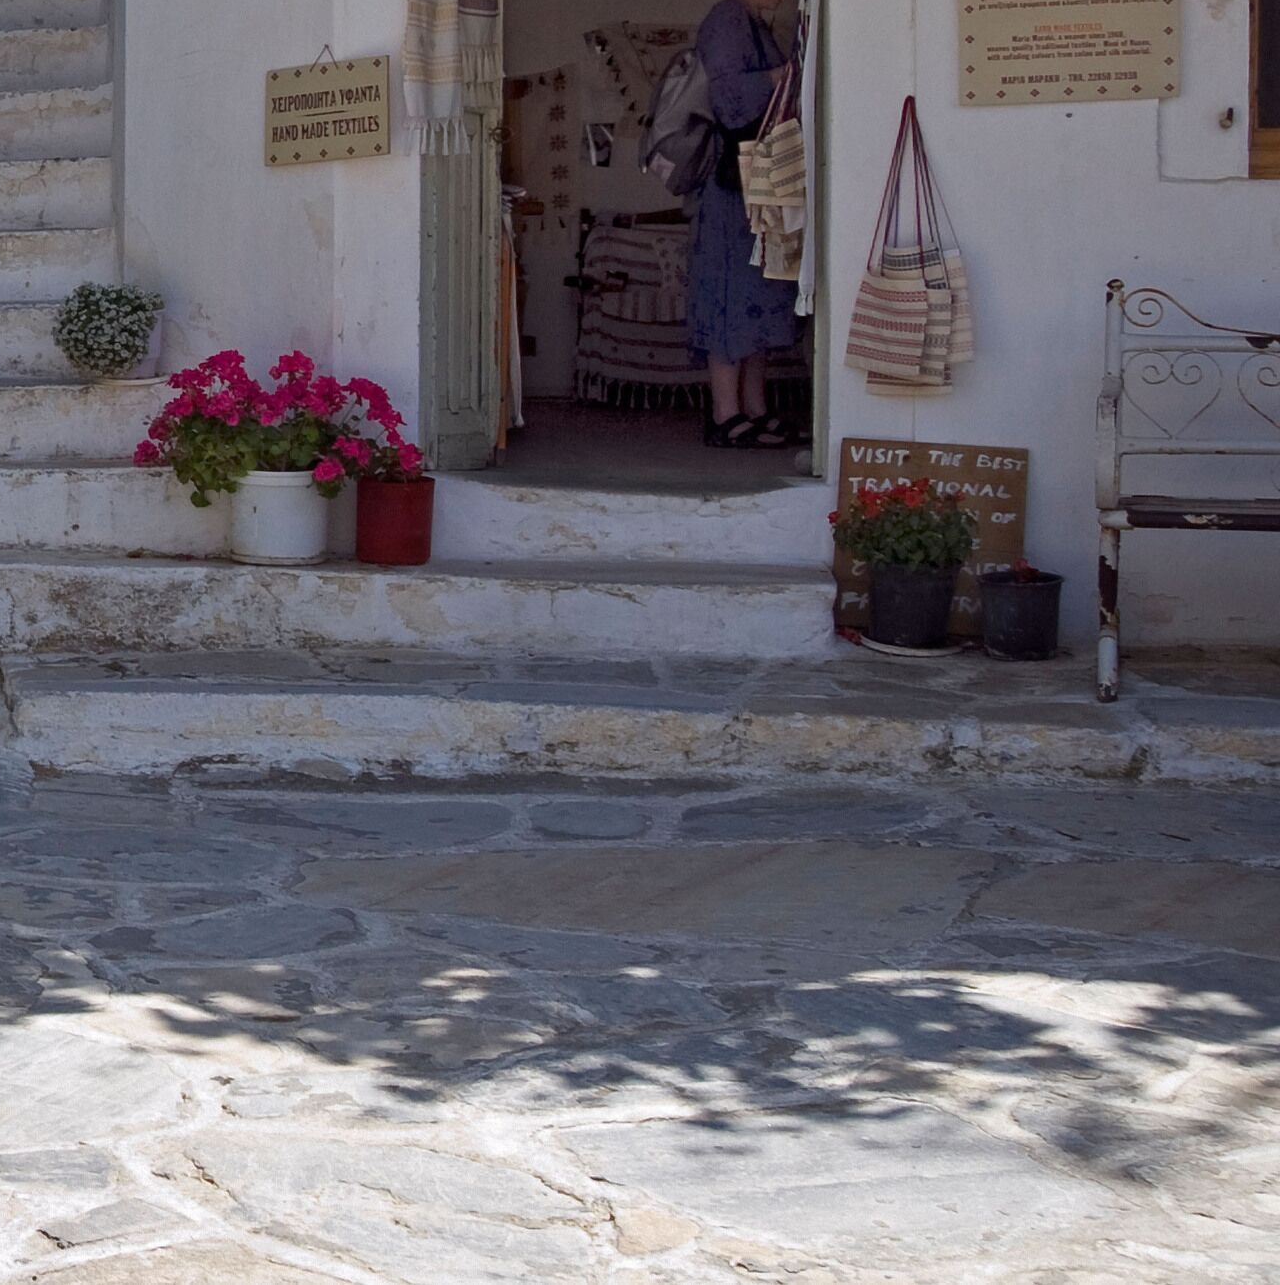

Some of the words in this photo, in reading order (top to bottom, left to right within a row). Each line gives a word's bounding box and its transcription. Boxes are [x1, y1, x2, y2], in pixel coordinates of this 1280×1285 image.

[272, 90, 336, 114] ΧΕΙΡΟΠΟΙΗΤΑ
[339, 85, 380, 105] ΥΦΑΝΤΑ
[272, 125, 298, 142] HAND
[301, 121, 329, 139] MADE
[332, 115, 380, 136] TEXTILES
[850, 446, 909, 466] VISIT
[928, 450, 964, 466] THE
[976, 454, 1027, 471] BEST
